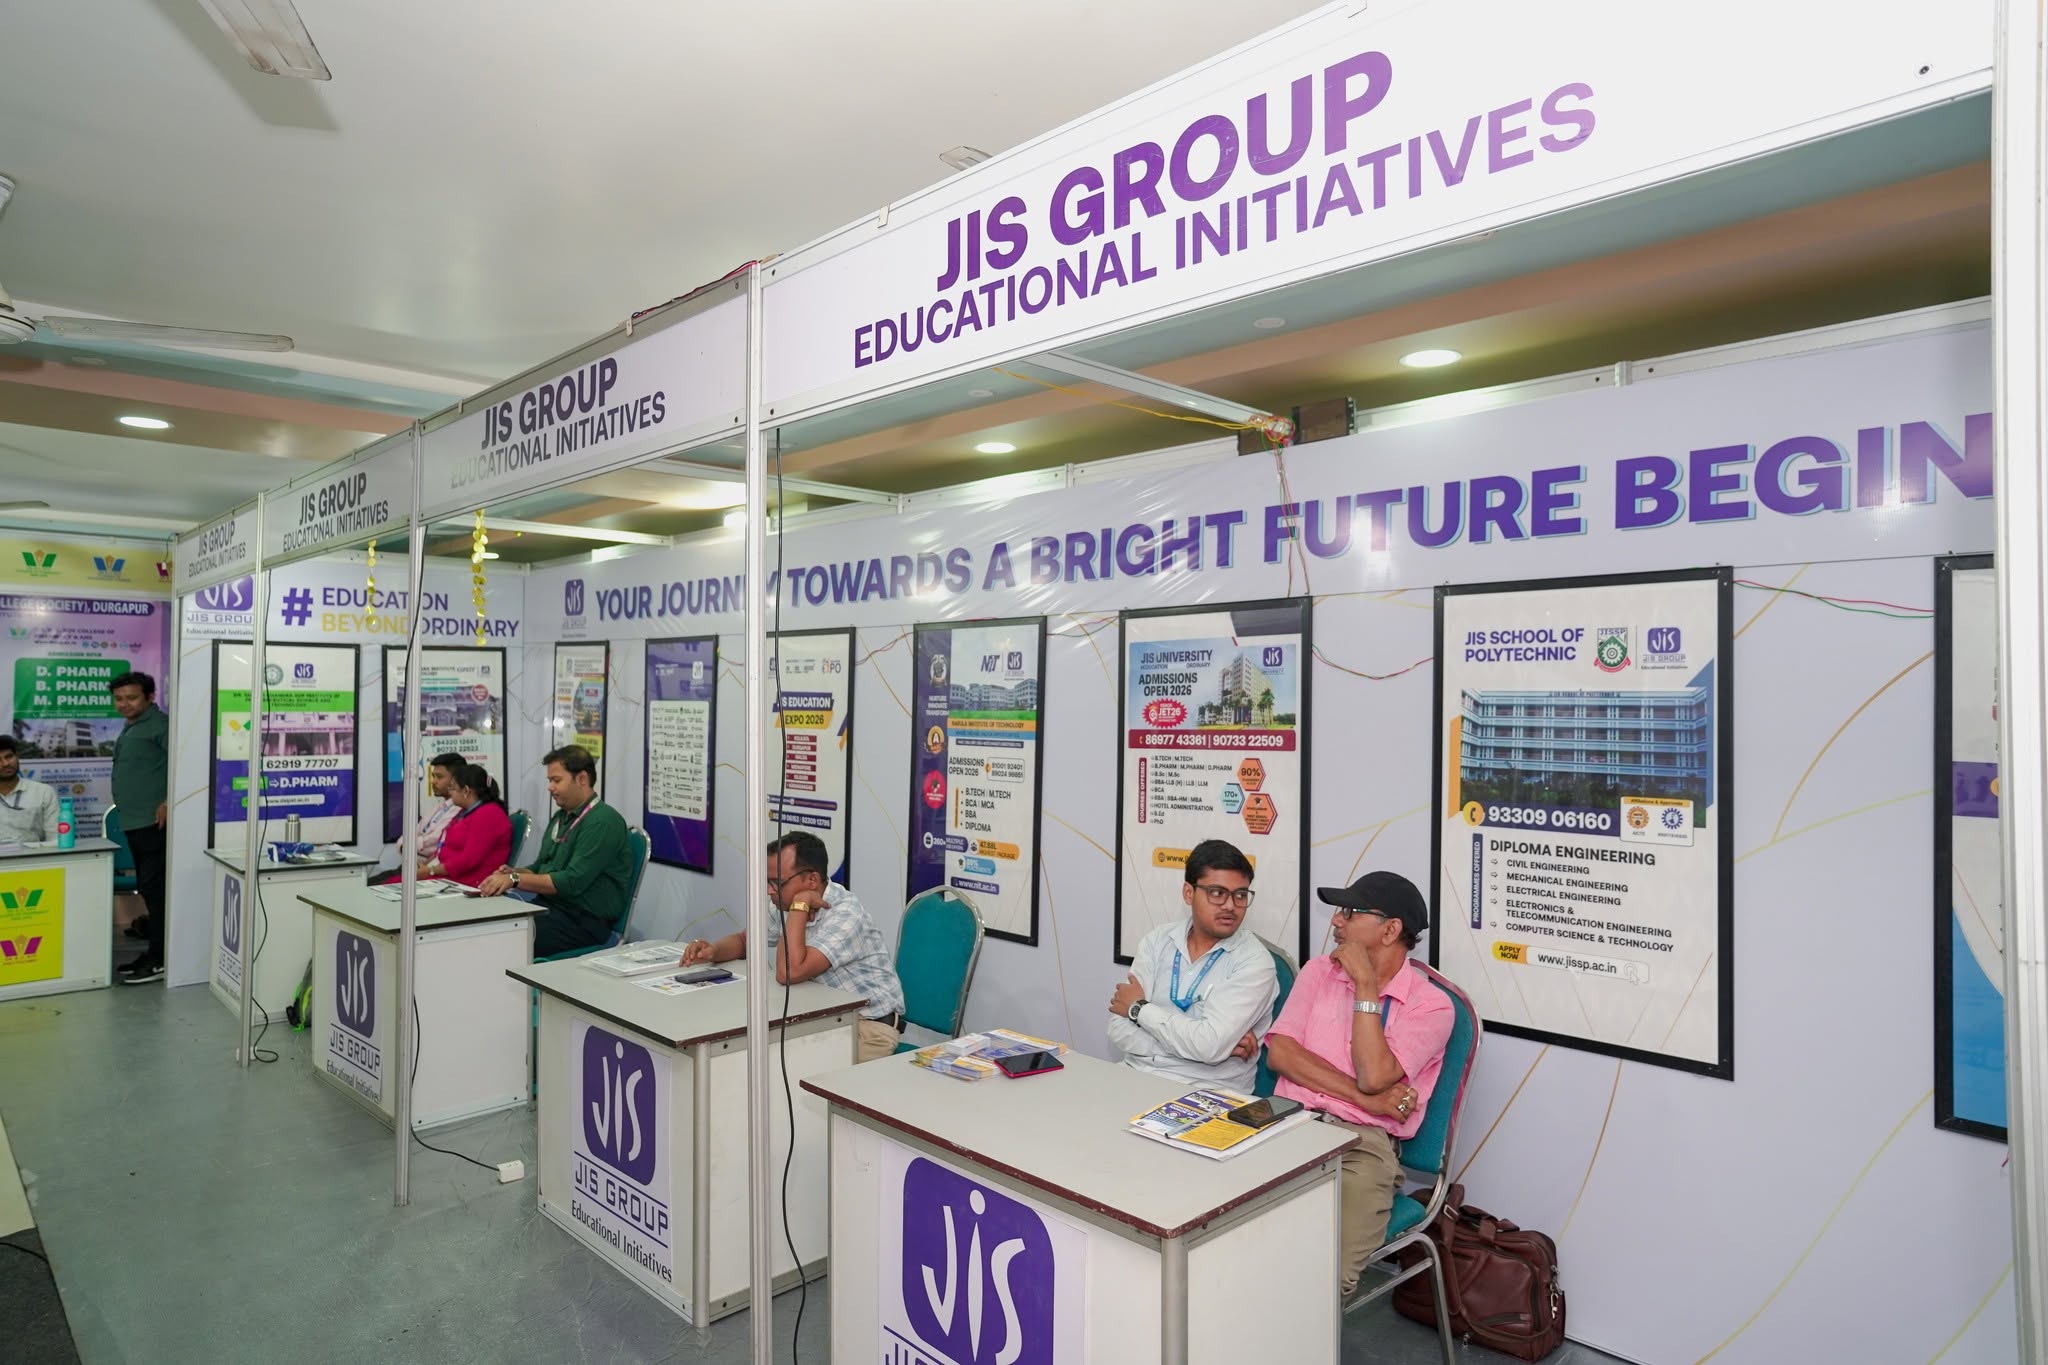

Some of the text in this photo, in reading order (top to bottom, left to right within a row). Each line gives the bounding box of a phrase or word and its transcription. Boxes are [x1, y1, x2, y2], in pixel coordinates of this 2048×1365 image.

[936, 51, 1392, 291] JIS GROUP
[854, 82, 1596, 368] EDUCATIONAL INITIATIVES
[481, 358, 617, 450] JIS GROUP
[451, 391, 665, 489] EDUCATIONAL INITIATIVES
[300, 472, 366, 525] JIS GROUP
[596, 412, 1994, 621] YOUR JOURNY TOWARDS A BRIGHT FUTURE BEGIN
[283, 501, 388, 552] EDUCATIONAL INITIATIVES
[198, 521, 235, 557] JIS GROUP
[189, 542, 246, 578] EDUCATIONAL INITIATIVES
[0, 598, 34, 610] LLEGE
[93, 602, 148, 614] DURGAPUR
[322, 587, 448, 611] EDUCATON
[214, 615, 254, 624] GROU
[421, 617, 519, 637] ORDINARY
[1465, 628, 1584, 645] JIS SCHOOL OF
[1600, 628, 1626, 636] JISSP
[1140, 650, 1212, 664] JIS UNIVERSITY
[1465, 646, 1576, 662] POLYTECHNIC
[1643, 654, 1686, 662] JIS GROUP
[36, 666, 111, 677] D. PHARM
[1139, 672, 1197, 685] ADMISSIONS
[36, 681, 110, 691] B. PHARM
[1144, 685, 1192, 696] OPEN 2026
[34, 695, 111, 706] M. PHARM
[789, 697, 831, 709] EDUCATION
[785, 715, 824, 725] EXPO 2026
[1158, 708, 1181, 716] JET26
[1145, 735, 1283, 747] 86977 43361 90733 22509
[266, 758, 339, 769] 62919 77707
[949, 757, 984, 767] ADMISSIONS
[1180, 763, 1204, 771] M.PHARM
[949, 766, 979, 776] OPEN 2026
[1241, 767, 1260, 777] 90%
[280, 776, 338, 788] D.PHARM
[965, 787, 1011, 799] B.TECH M.TECH
[965, 799, 994, 809] BCA MCA
[1170, 804, 1213, 812] ADMINISTRATION
[965, 810, 976, 818] BBA
[1488, 806, 1611, 830] 93309 06160
[965, 822, 991, 832] DIPLOMA
[1491, 839, 1656, 866] DIPLOMA ENGINEERING
[1507, 859, 1590, 875] CIVIL ENGINEERING
[1507, 872, 1628, 893] MECHANICAL ENGINEERING
[1507, 885, 1621, 906] ELECTRICAL ENGINEERING
[1506, 899, 1574, 915] ELECTRONICS &
[1506, 909, 1672, 938] TELECOMMUNICATION ENGINEERING
[1506, 923, 1674, 953] COMPUTER SCIENCE & TECHNOLOGY
[1498, 944, 1521, 955] APPLY
[1501, 951, 1519, 961] NOW
[1538, 953, 1617, 974] www.jissp.ac.in
[330, 1029, 381, 1070] JIS GROUP
[327, 1059, 355, 1087] Educational
[575, 1161, 669, 1236] JIS GROUP
[571, 1200, 672, 1283] Educational Initiatives
